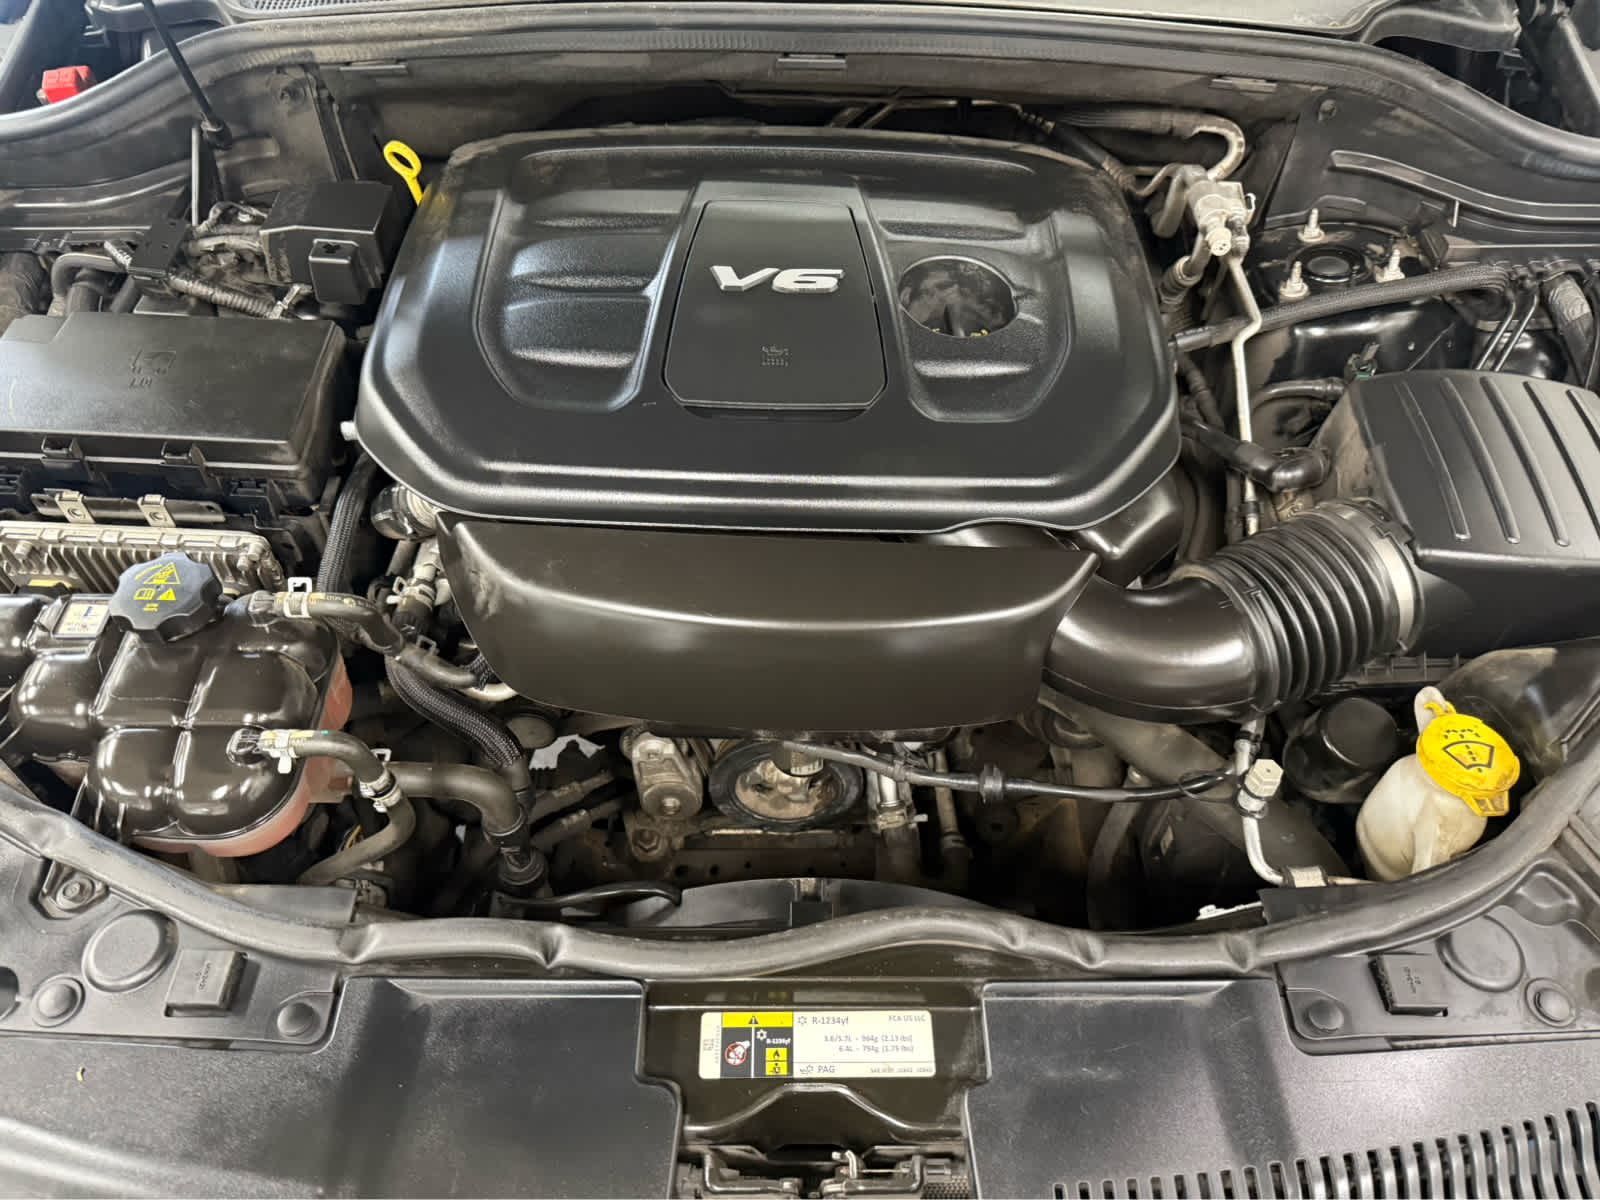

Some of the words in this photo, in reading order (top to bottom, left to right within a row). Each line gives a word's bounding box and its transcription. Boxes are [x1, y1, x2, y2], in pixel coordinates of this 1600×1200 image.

[709, 265, 845, 294] V6
[812, 1016, 849, 1026] R-1234yf
[817, 1065, 836, 1073] PAG
